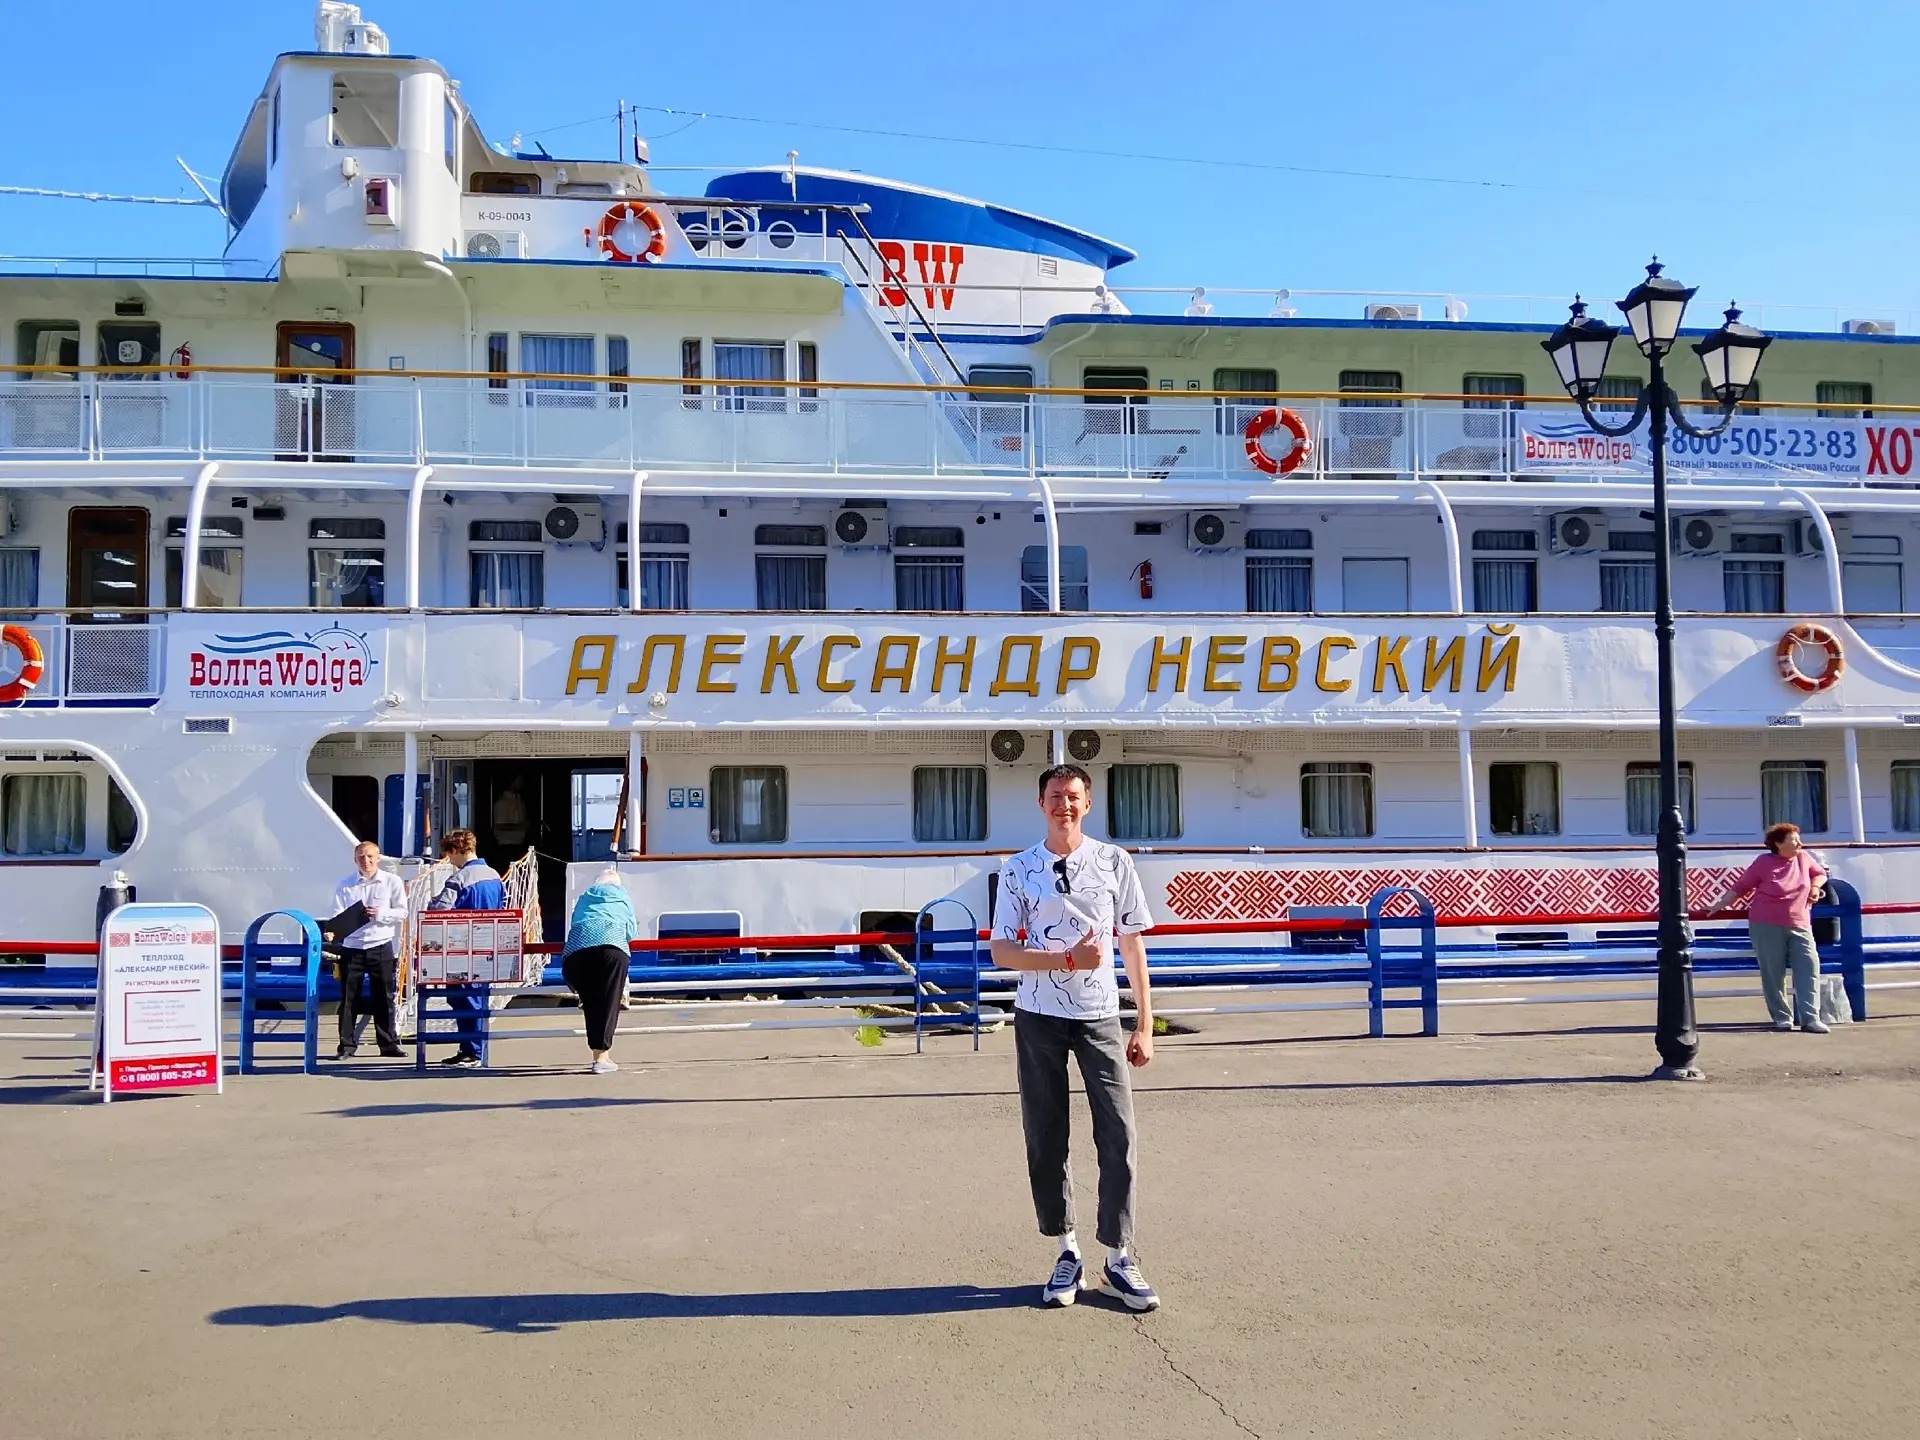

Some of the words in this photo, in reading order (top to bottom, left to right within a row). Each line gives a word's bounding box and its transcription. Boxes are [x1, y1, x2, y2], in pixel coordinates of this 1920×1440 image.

[1525, 435, 1633, 465] ВолгаWolga
[189, 652, 363, 693] ВолгаWolga
[566, 635, 1101, 697] АЛЕКСАНДР
[1149, 624, 1521, 693] НЕВСКИЙ
[189, 690, 265, 699] ТЕПЛОХОДНАЯ
[269, 690, 327, 699] КОМПАНИЯ
[141, 954, 184, 962] ТЕПЛОХОД
